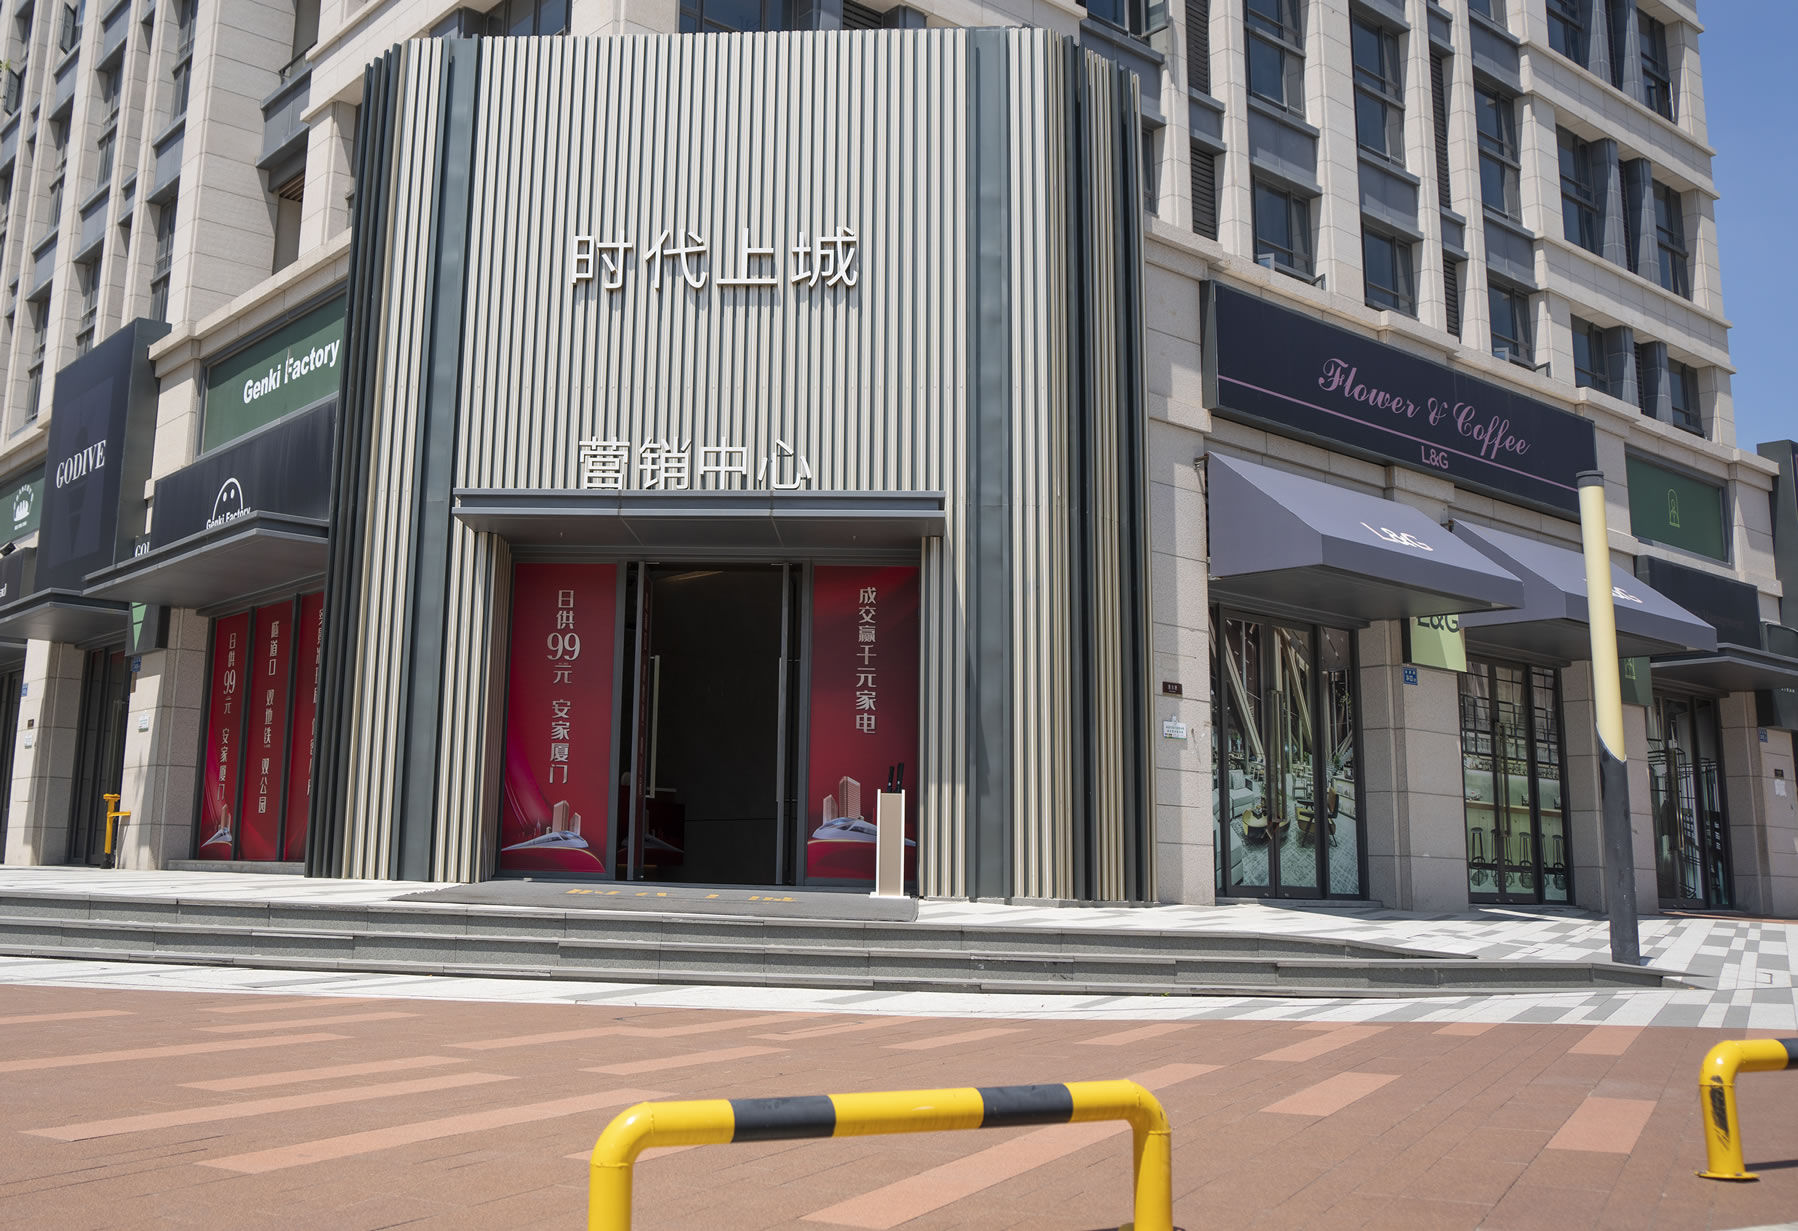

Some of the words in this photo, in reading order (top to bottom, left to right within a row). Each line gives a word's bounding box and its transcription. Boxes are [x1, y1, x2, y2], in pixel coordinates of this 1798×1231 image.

[572, 226, 858, 291] 时代上城
[243, 368, 281, 404] Genki
[284, 339, 340, 383] Factory
[1318, 358, 1421, 418] Flower
[1427, 397, 1448, 426] &
[1453, 402, 1532, 460] Coffee
[56, 439, 106, 489] GODIVE
[578, 436, 813, 490] 营销中心
[1421, 445, 1449, 469] L&G
[206, 514, 225, 530] Genki
[225, 506, 251, 523] Factory
[1360, 521, 1434, 552] L&G
[546, 589, 581, 685] 日供99元
[855, 586, 877, 734] 成交赢千元家电
[223, 632, 237, 715] 日供99元
[263, 688, 275, 744] 双地铁
[549, 698, 572, 785] 安家厦门
[217, 727, 229, 801] 安家厦门
[258, 757, 270, 814] 双公园
